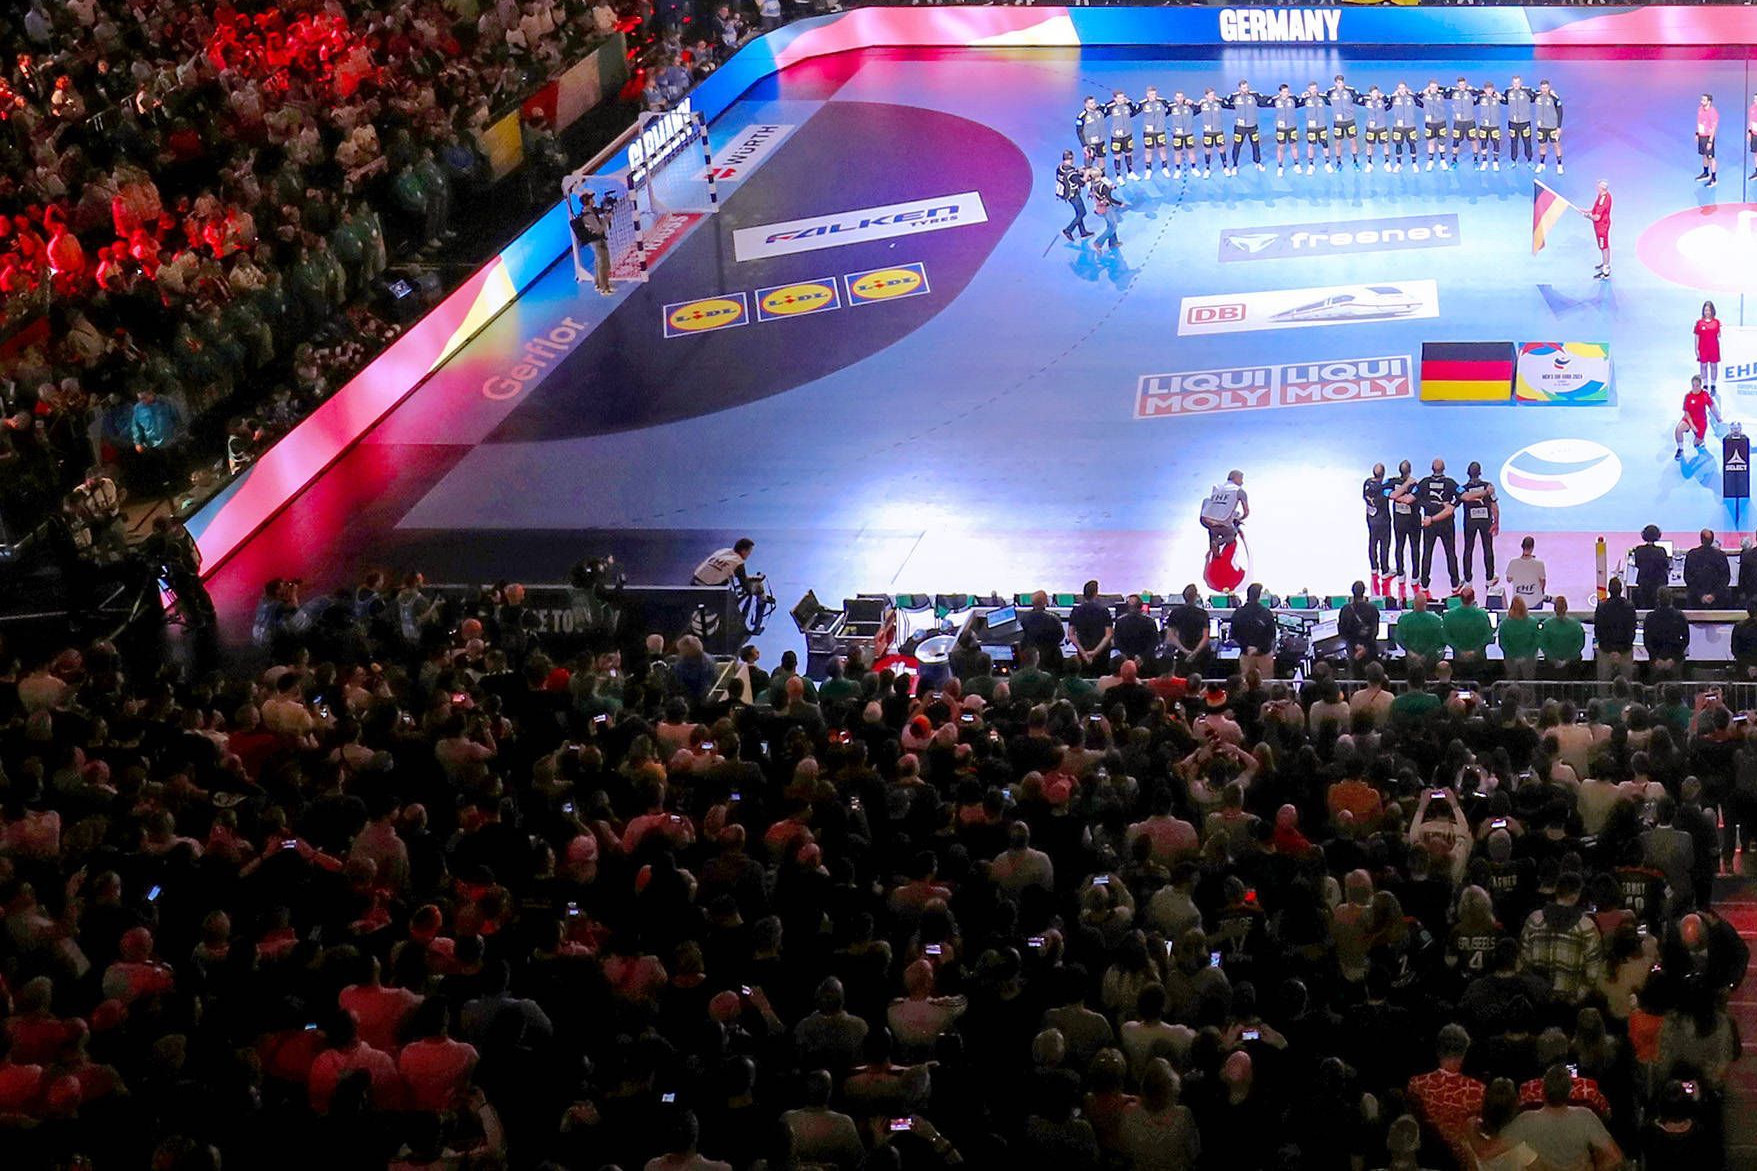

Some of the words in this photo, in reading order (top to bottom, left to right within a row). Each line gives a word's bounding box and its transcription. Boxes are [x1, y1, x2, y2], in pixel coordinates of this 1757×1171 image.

[1220, 9, 1341, 41] GERMANY
[723, 125, 779, 166] WÜRTH
[766, 204, 960, 244] FALKEN
[910, 214, 959, 227] TYRES
[1290, 223, 1452, 249] freenet
[1195, 307, 1239, 322] DB
[482, 316, 586, 400] Gerflor
[1149, 370, 1265, 395] LIQUI
[1287, 360, 1401, 385] LIQUI
[1146, 389, 1269, 415] MOLY
[1287, 378, 1402, 404] MOLY
